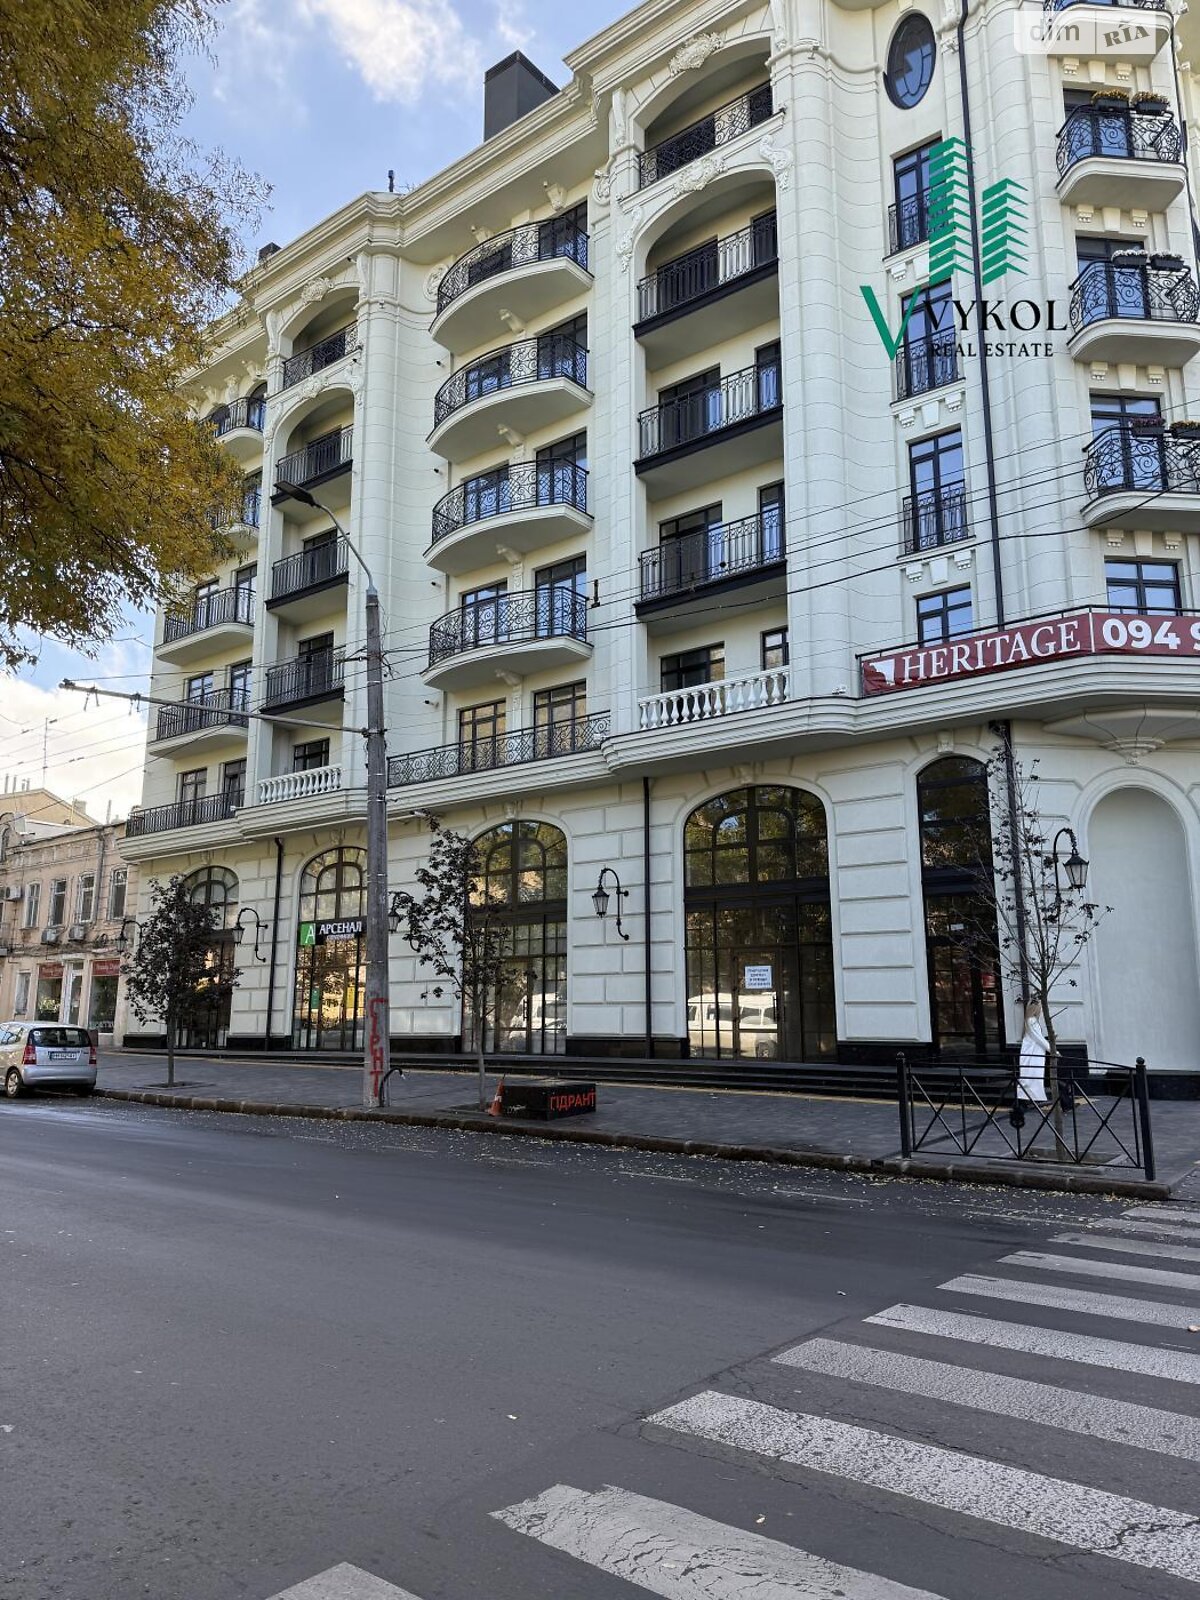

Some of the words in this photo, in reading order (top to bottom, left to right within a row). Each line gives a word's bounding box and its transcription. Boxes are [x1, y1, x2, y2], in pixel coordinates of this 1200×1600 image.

[1102, 618, 1181, 649] 094
[902, 620, 1080, 684] HERITAGE
[319, 921, 362, 935] АРСЕНАЛ
[550, 1088, 596, 1111] ГІДРАНТ
